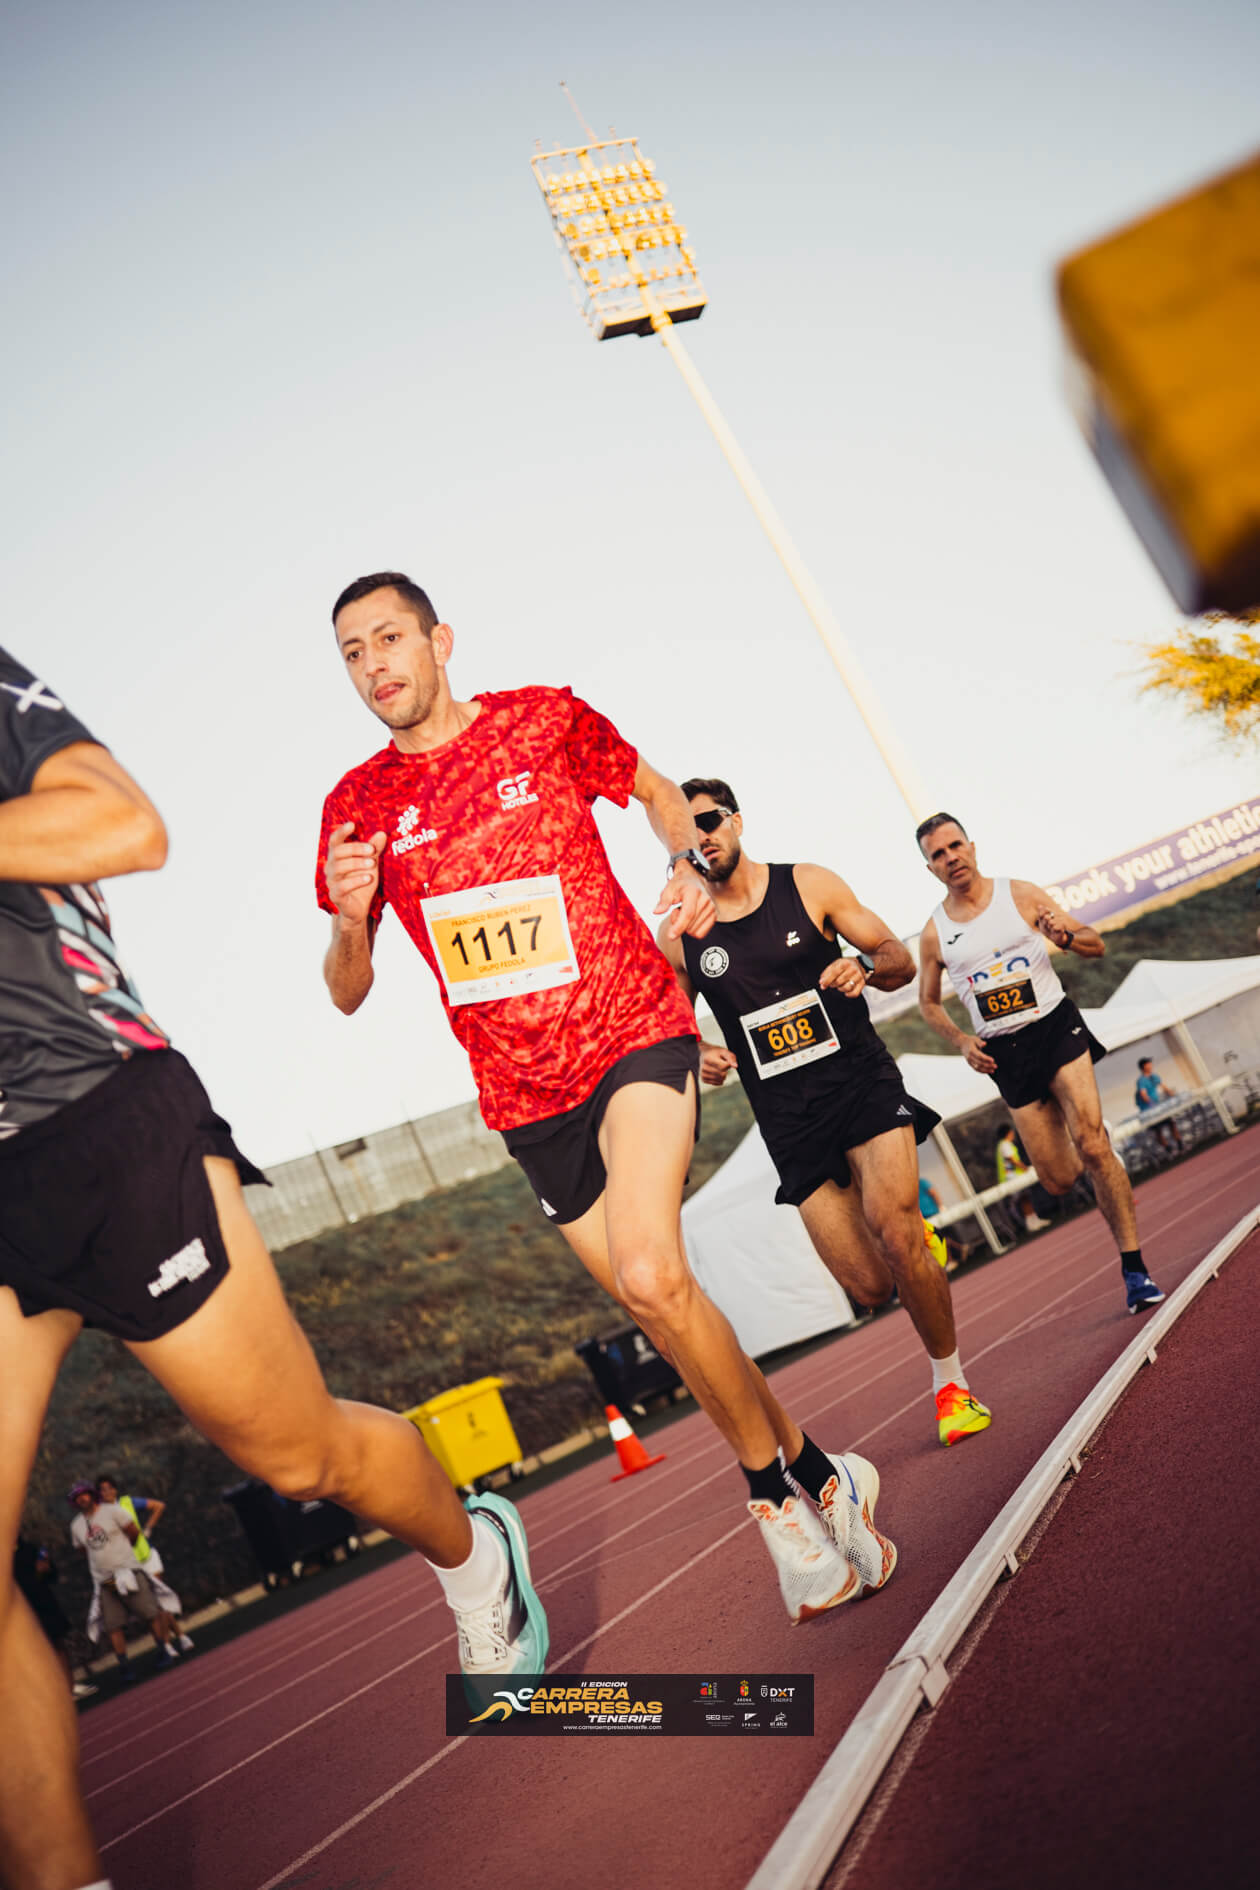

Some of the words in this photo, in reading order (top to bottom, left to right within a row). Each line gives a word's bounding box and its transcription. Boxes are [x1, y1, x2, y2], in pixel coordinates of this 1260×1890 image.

[496, 771, 530, 801] GF
[502, 793, 539, 811] HOTELES
[392, 828, 438, 856] fedola
[1114, 844, 1175, 894] your
[451, 915, 542, 966] 1117
[987, 988, 1024, 1013] 632
[768, 1017, 813, 1051] 608
